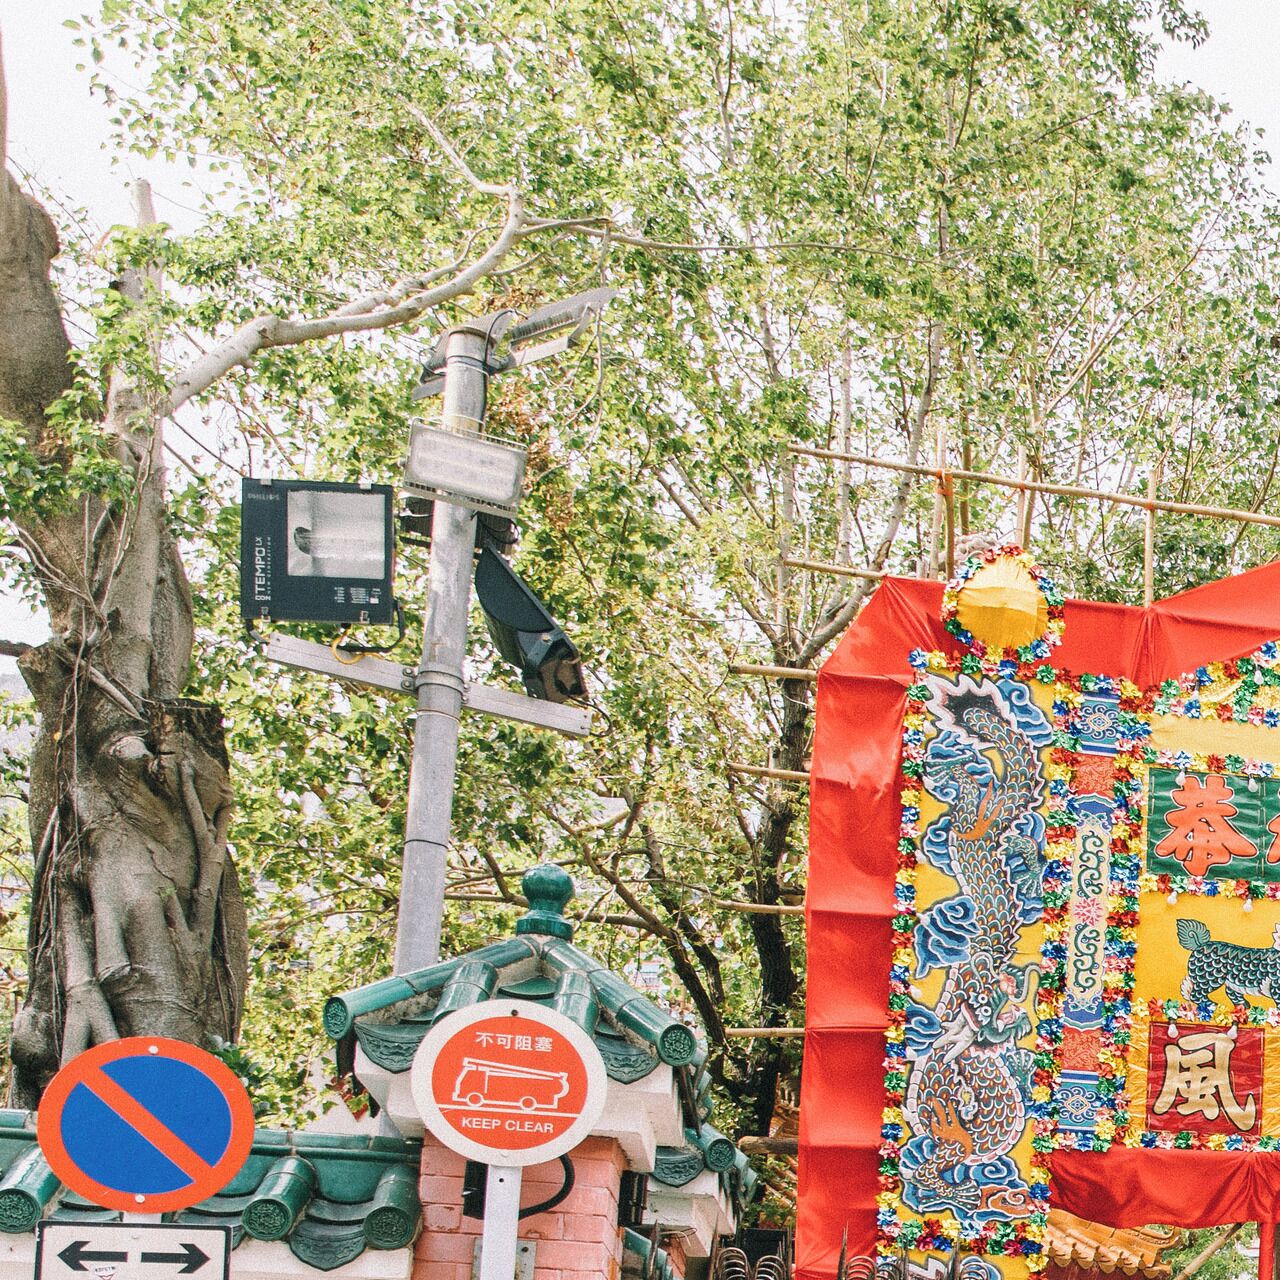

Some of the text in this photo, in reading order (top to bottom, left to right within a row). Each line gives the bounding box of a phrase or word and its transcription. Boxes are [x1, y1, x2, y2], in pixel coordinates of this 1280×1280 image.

[255, 547, 265, 594] TEMPO
[475, 1031, 553, 1053] 不可阻塞
[461, 1117, 554, 1133] KEEP CLEAR
